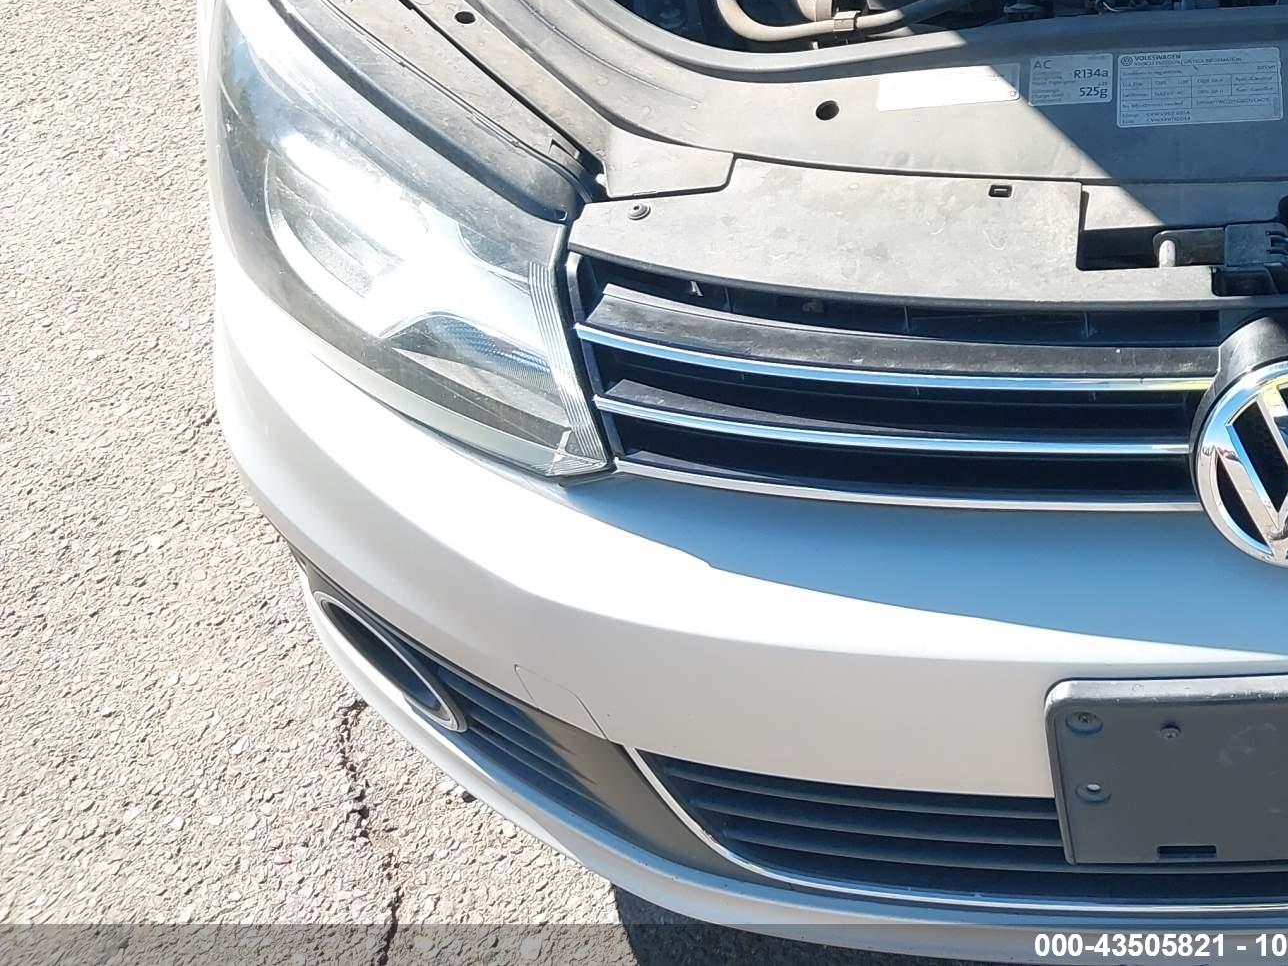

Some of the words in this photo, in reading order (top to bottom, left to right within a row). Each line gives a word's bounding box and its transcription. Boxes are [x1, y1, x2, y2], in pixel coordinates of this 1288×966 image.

[1033, 59, 1053, 70] AC
[1073, 68, 1109, 79] R134a
[1079, 86, 1108, 99] 525g
